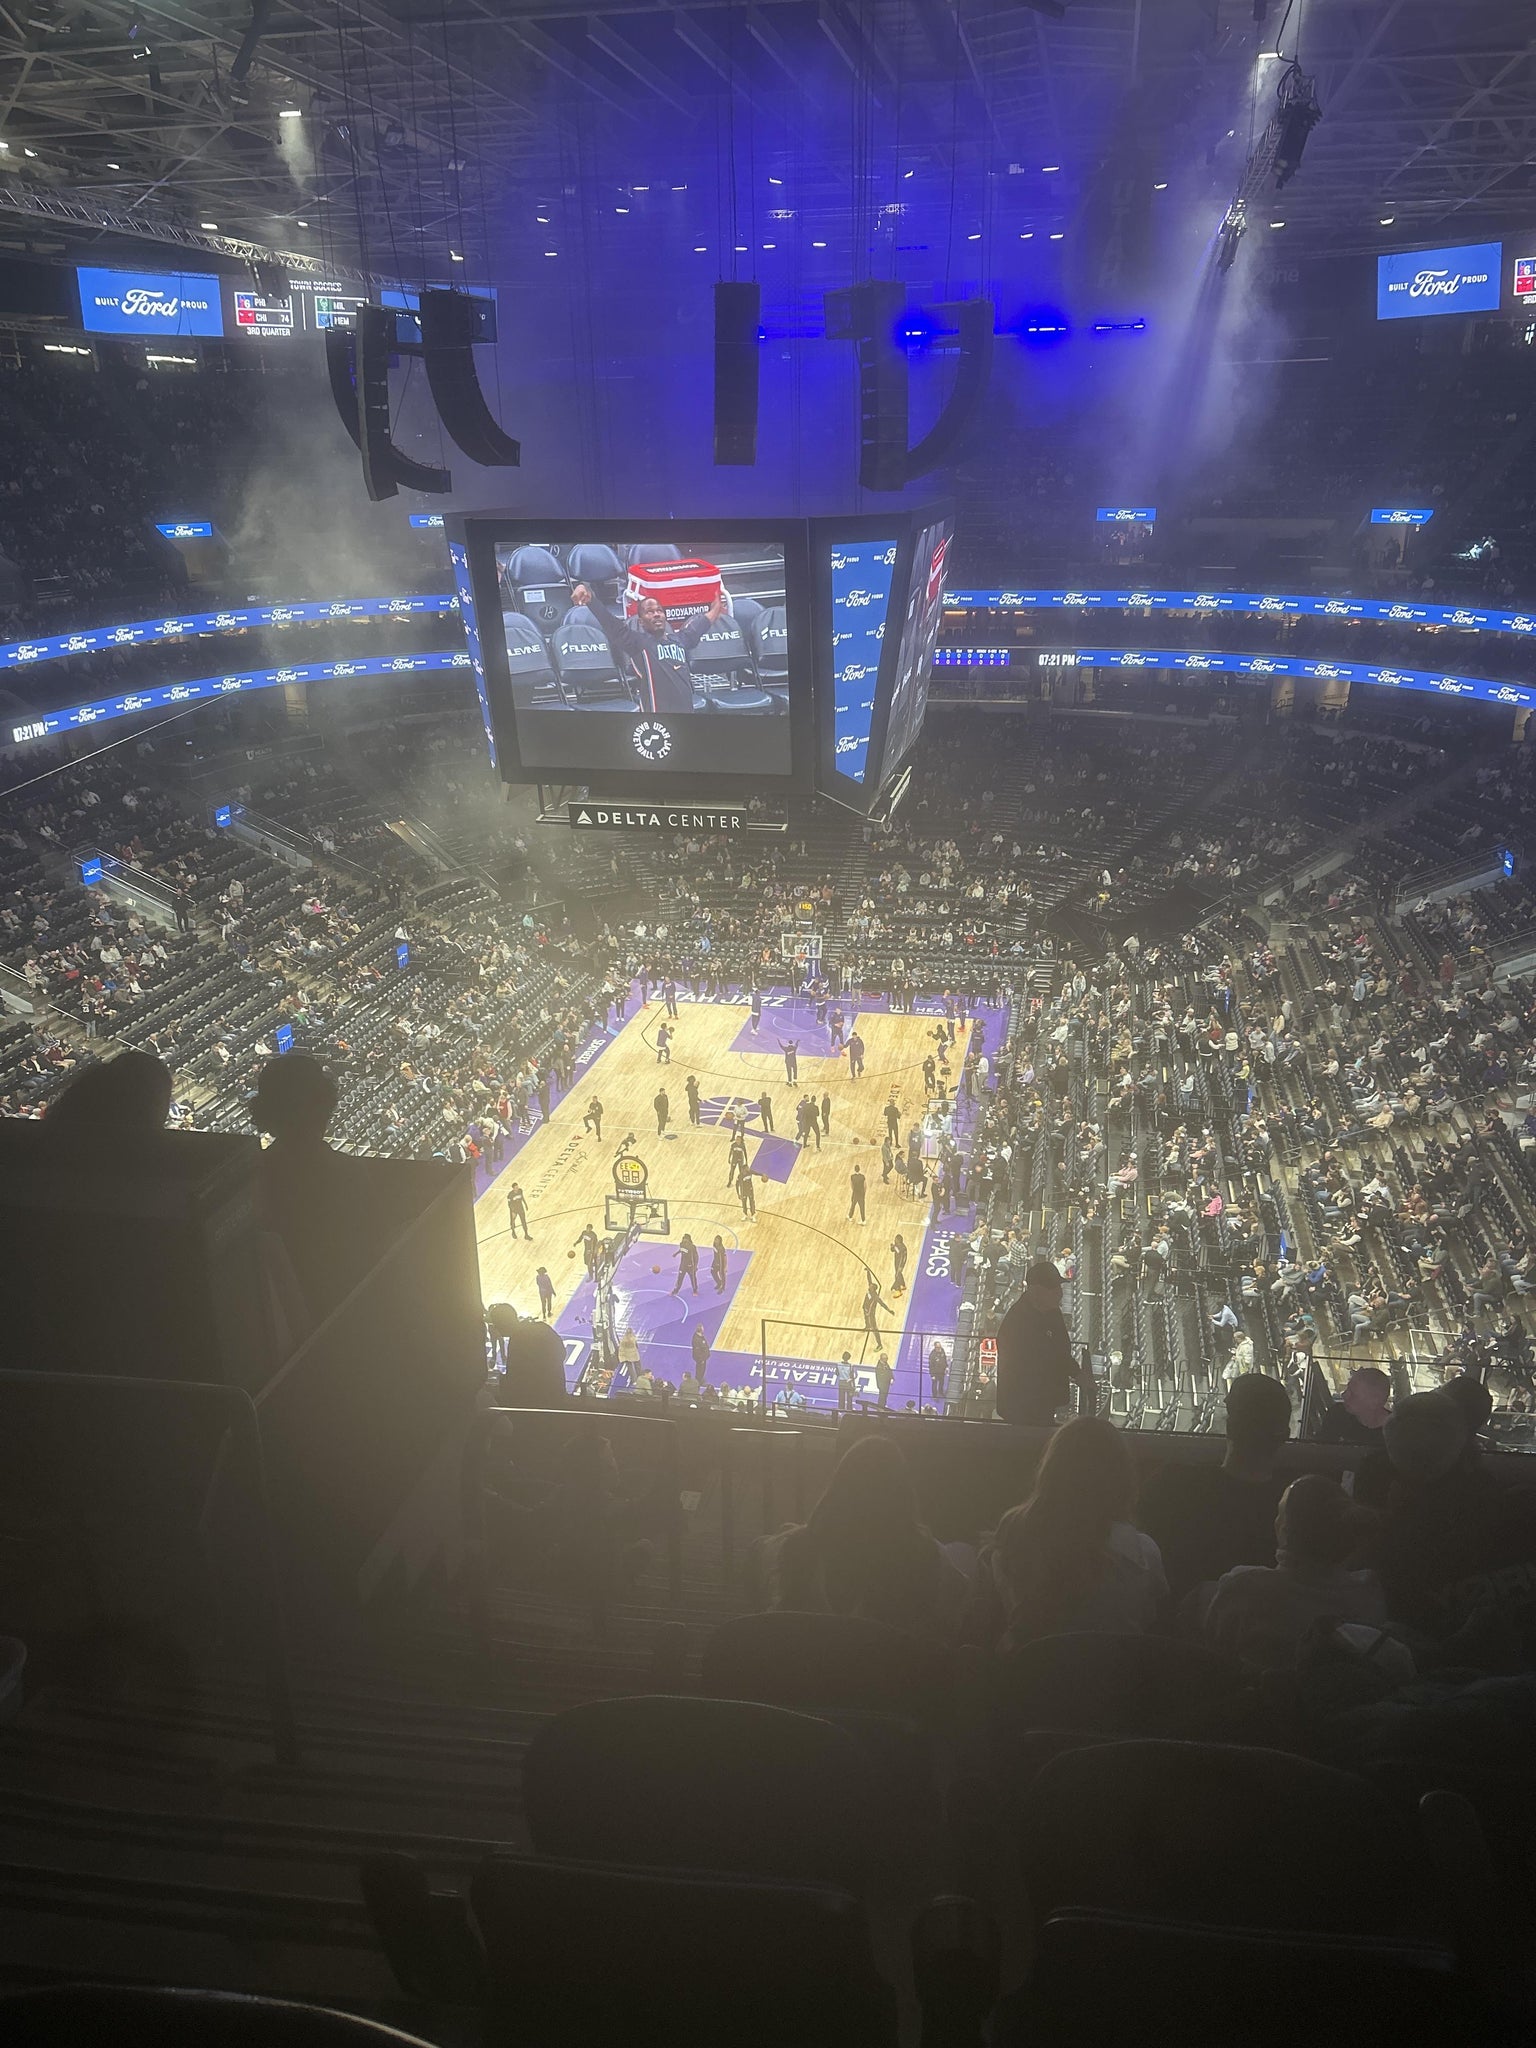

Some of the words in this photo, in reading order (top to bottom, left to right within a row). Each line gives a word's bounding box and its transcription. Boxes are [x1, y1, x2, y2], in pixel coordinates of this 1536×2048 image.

[1388, 282, 1409, 292] BUILT
[1409, 269, 1461, 298] Ford
[1461, 274, 1488, 284] PROUD
[95, 297, 119, 307] BUILT
[121, 289, 179, 317] Ford
[180, 301, 208, 310] PROUD
[261, 327, 291, 337] QUARTER
[846, 590, 872, 608] Ford
[999, 593, 1024, 605] Ford
[1063, 593, 1088, 605] Ford
[1128, 593, 1154, 606] Ford
[1194, 594, 1220, 607] Ford
[1259, 597, 1286, 610] Ford
[1324, 600, 1351, 614] Ford
[1389, 605, 1415, 619] Ford
[1452, 610, 1476, 625] Ford
[1511, 616, 1535, 631] Ford
[569, 643, 608, 653] FILEVINE
[1038, 654, 1060, 666] 07:21
[1062, 654, 1075, 666] PM
[1121, 653, 1147, 665] Ford
[1185, 655, 1212, 668] Ford
[1250, 659, 1276, 672] Ford
[842, 664, 867, 682] Ford
[12, 724, 33, 743] 07:21
[32, 721, 45, 738] PM
[652, 721, 671, 739] UTAH
[632, 721, 655, 760] BASKETBALL
[836, 735, 859, 754] Ford
[656, 739, 672, 759] JAZZ
[597, 811, 661, 826] DELTA
[668, 813, 740, 829] CENTER
[925, 1238, 950, 1278] PACS
[750, 1365, 838, 1386] HEALTH
